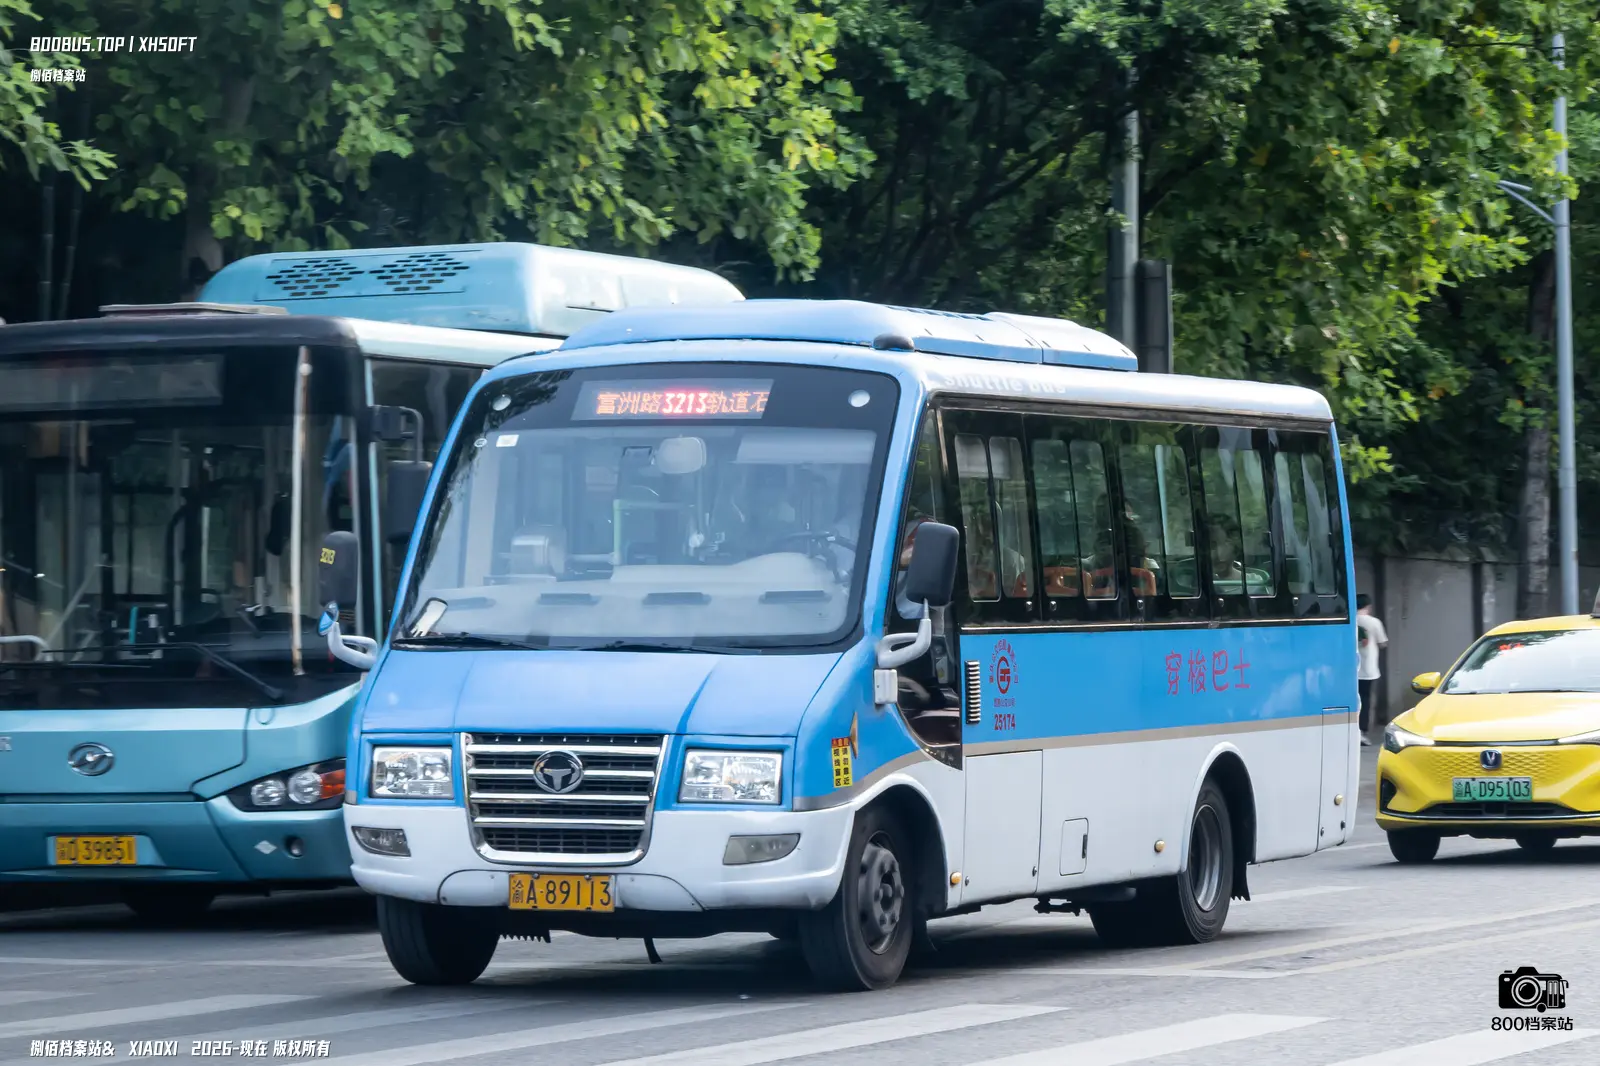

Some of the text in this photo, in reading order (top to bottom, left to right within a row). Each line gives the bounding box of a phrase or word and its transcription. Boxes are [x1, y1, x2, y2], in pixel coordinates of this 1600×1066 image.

[1165, 647, 1252, 695] 穿梭巴士
[994, 713, 1016, 731] 25174
